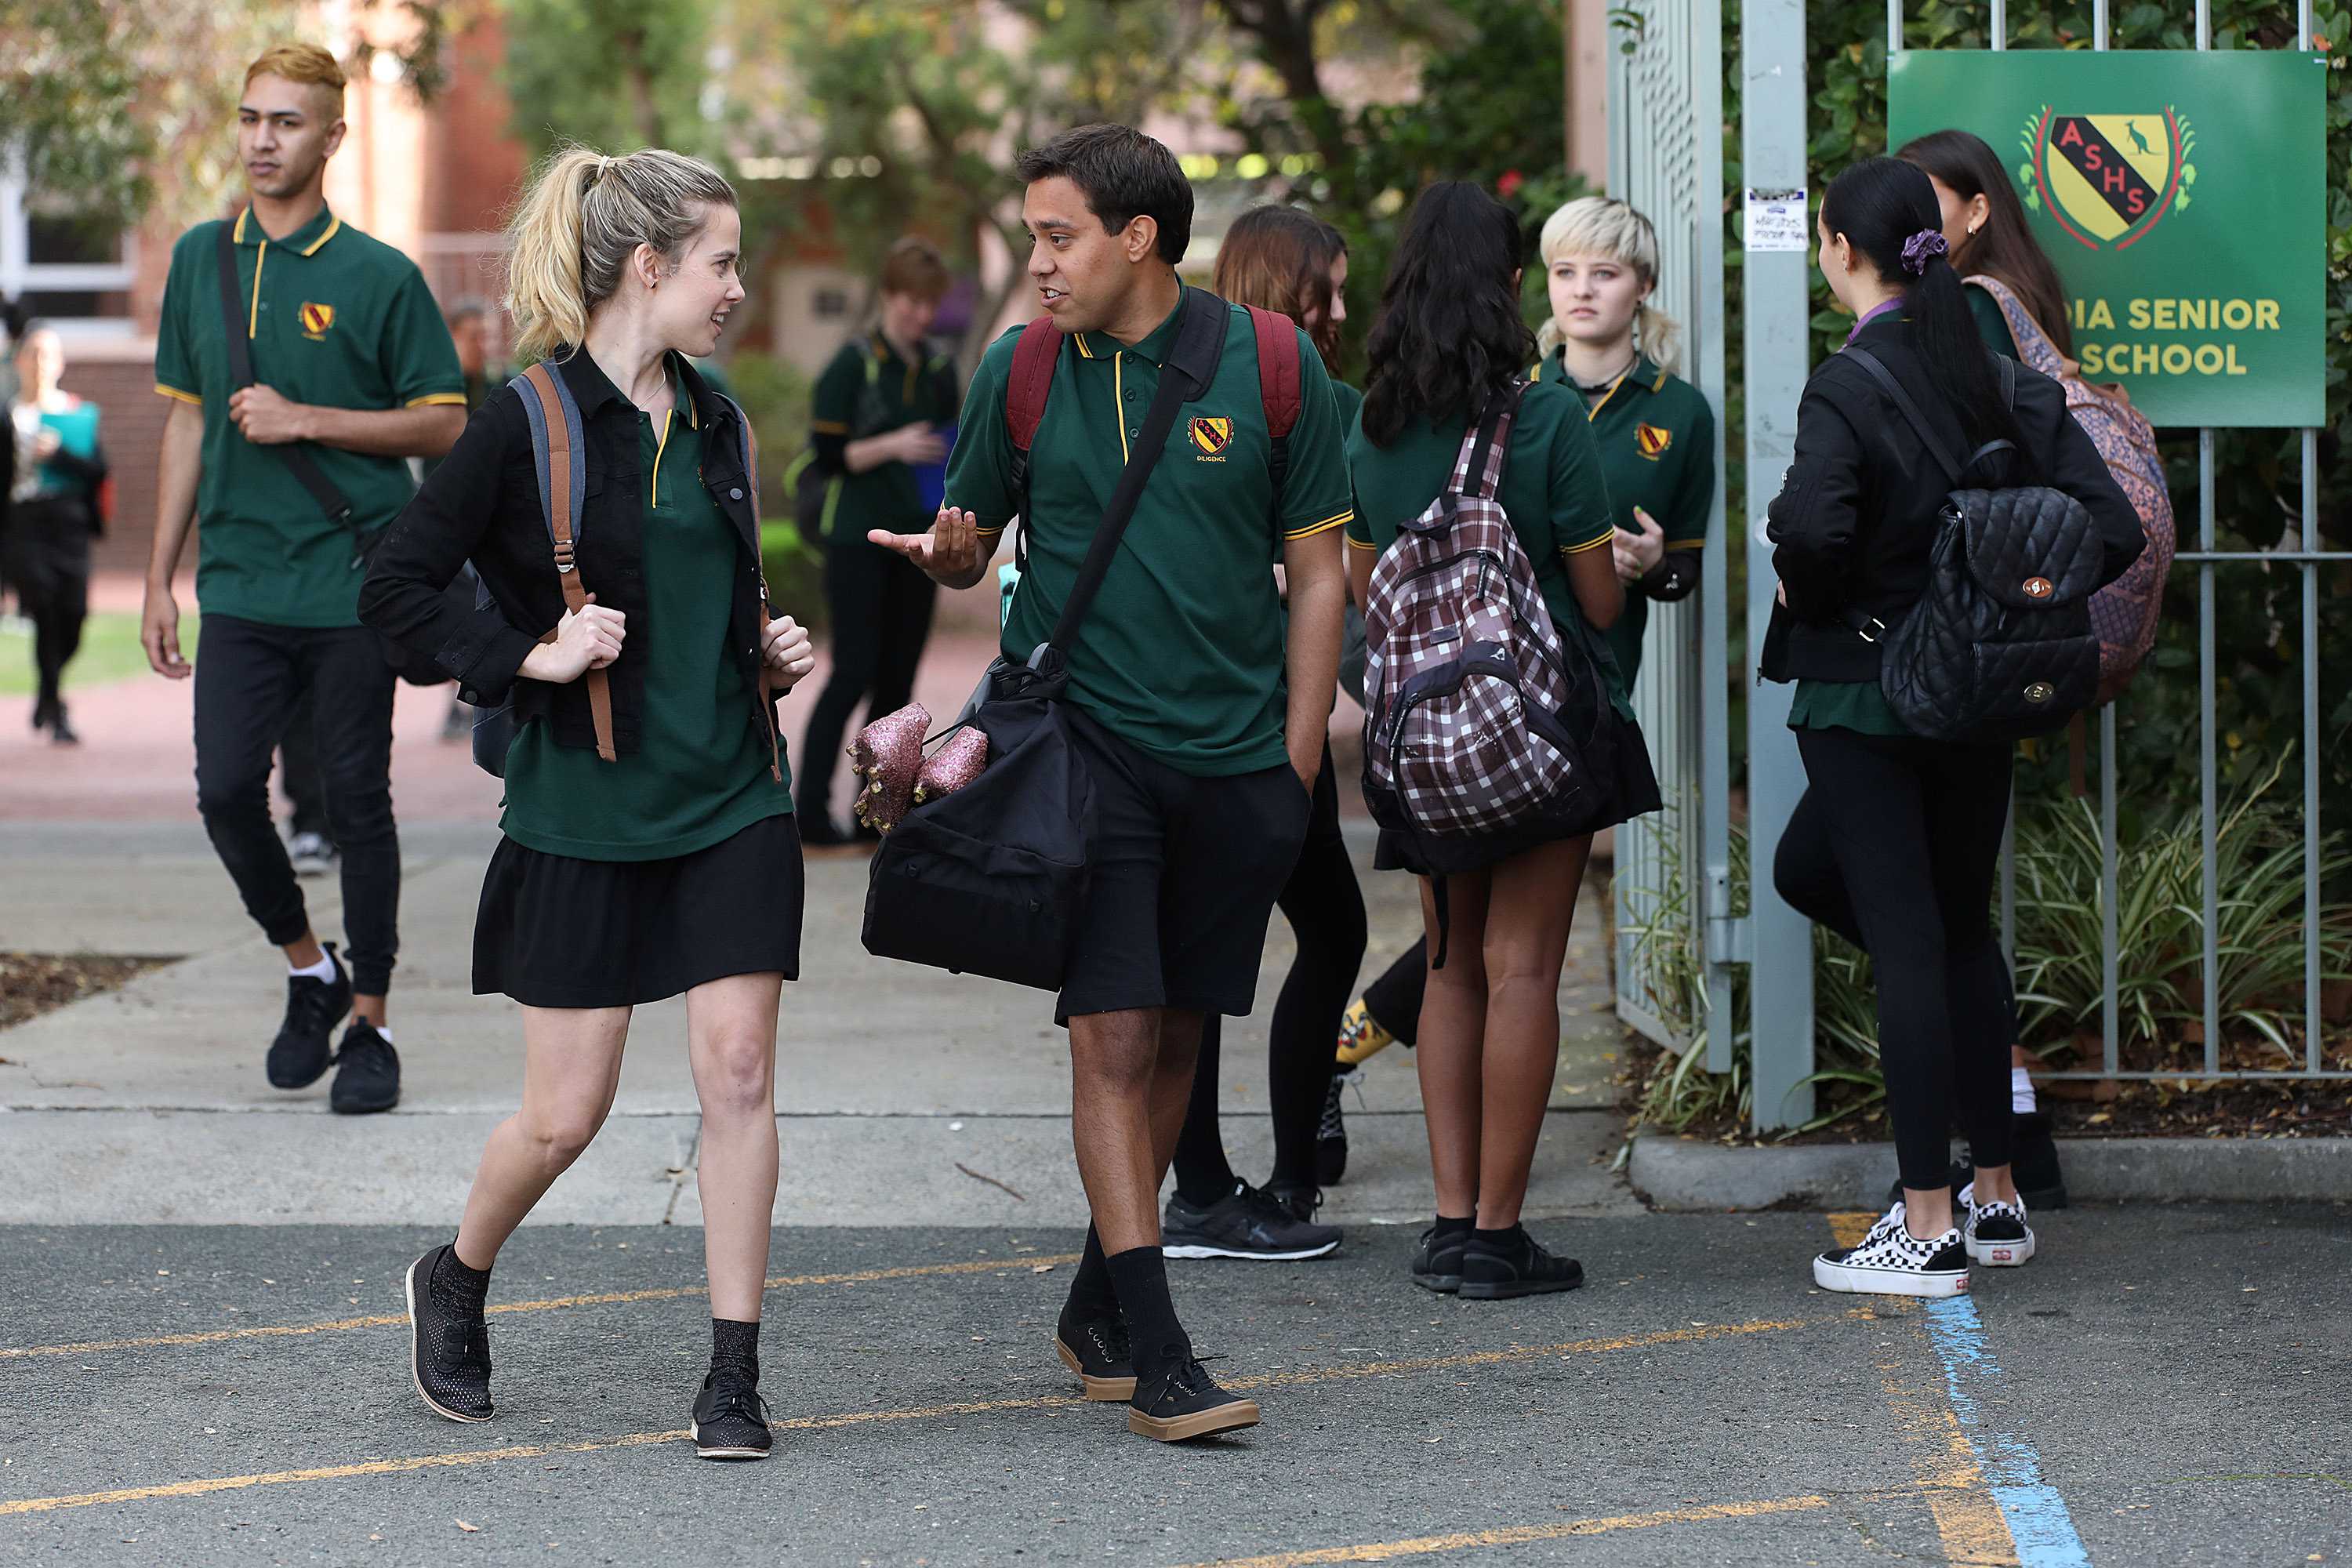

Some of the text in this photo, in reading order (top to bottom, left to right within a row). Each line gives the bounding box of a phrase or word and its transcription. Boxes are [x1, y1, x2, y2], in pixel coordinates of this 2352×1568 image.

[2060, 119, 2145, 214] ASHS
[2128, 298, 2280, 330] SENIOR
[2080, 343, 2247, 375] SCHOOL
[1198, 420, 1221, 445] ASHS
